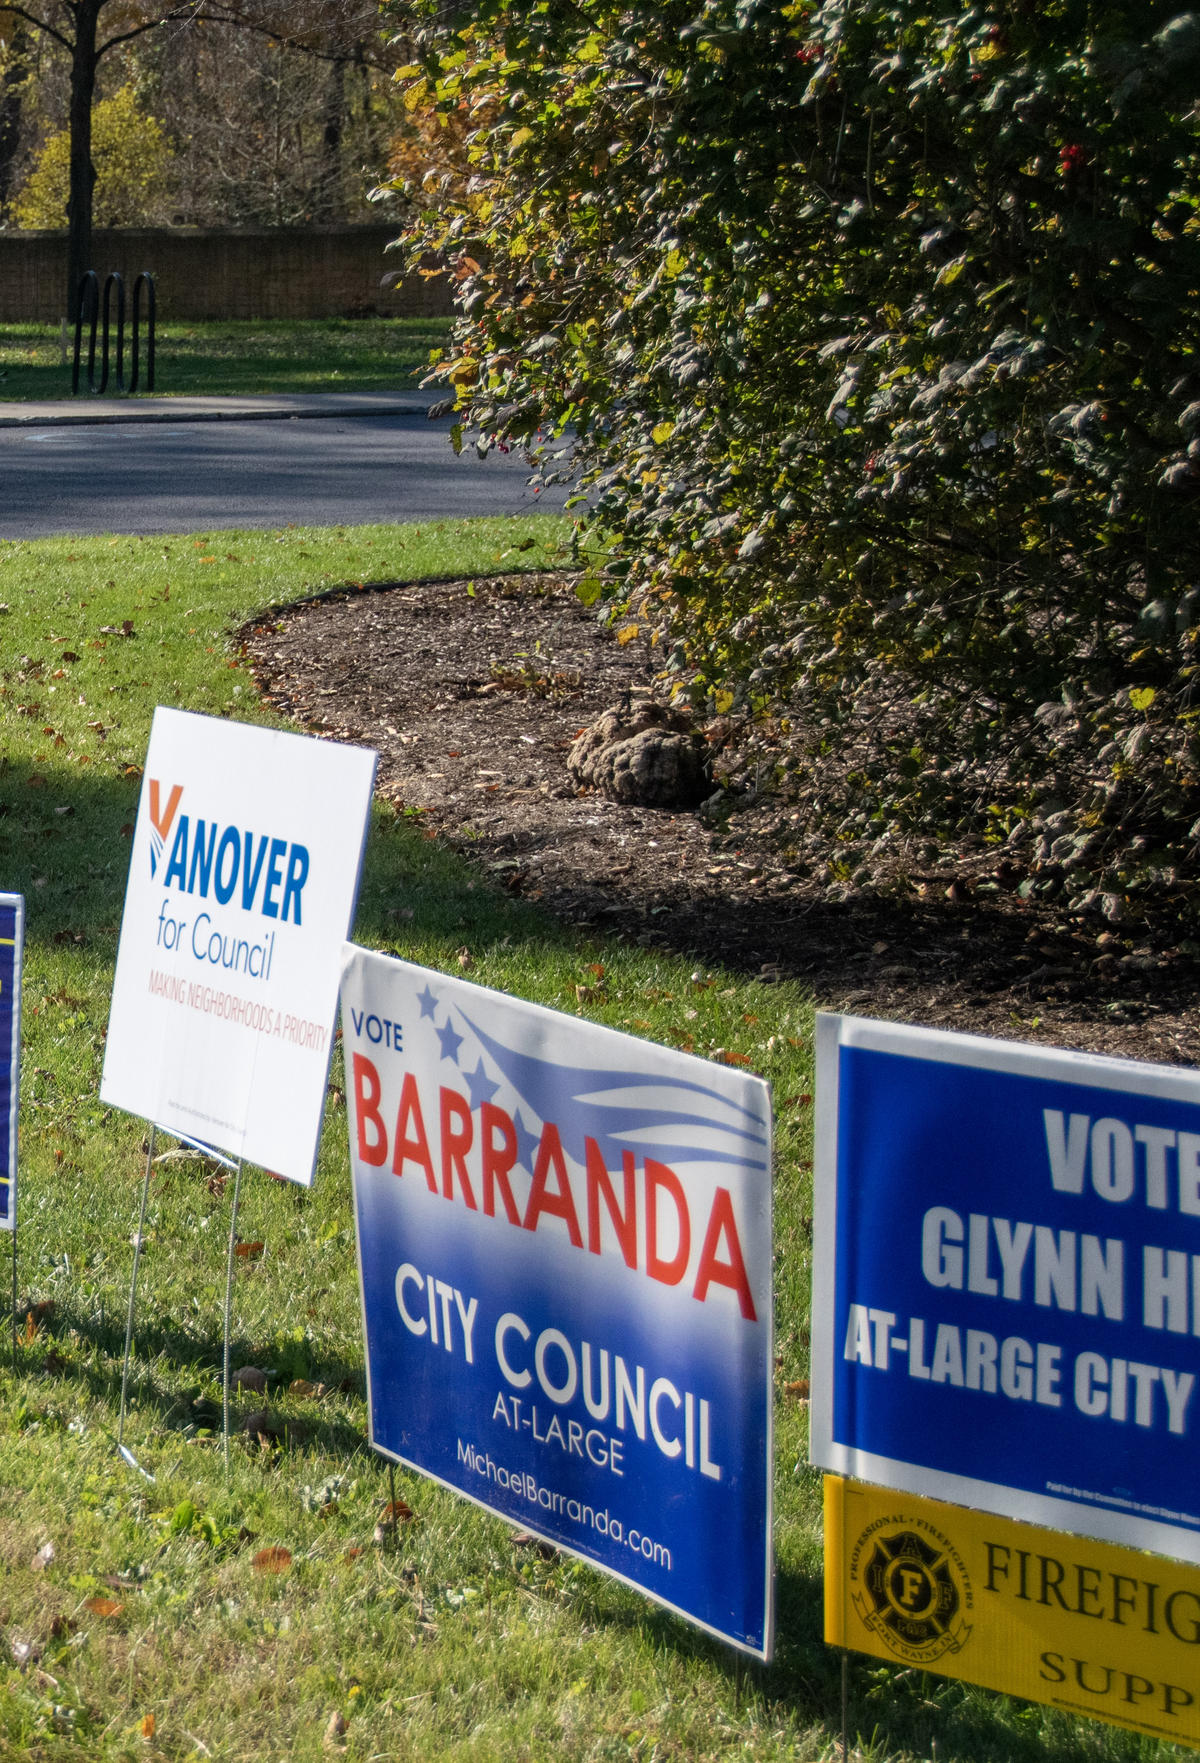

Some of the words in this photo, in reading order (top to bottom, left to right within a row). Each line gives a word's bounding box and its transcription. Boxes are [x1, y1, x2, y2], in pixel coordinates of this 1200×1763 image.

[149, 779, 310, 926] VANOVER
[156, 898, 186, 951] for
[191, 912, 276, 981] Council
[148, 969, 187, 1004] MAKING
[187, 981, 275, 1034] NEIGHBORHOODS
[274, 1011, 282, 1038] A
[283, 1013, 328, 1052] PRIORITY
[350, 1007, 403, 1053] VOTE
[352, 1051, 758, 1323] BARRANDA
[921, 1206, 1124, 1322] GLYNN
[394, 1263, 478, 1364] CITY
[494, 1312, 721, 1481] COUNCIL
[844, 1303, 1062, 1407] AT-LARGE
[1074, 1351, 1195, 1435] CITY
[492, 1391, 625, 1476] AT-LARGE
[456, 1437, 672, 1571] MichaelBarranda.com
[851, 1514, 907, 1581] PROFESSIONAL
[916, 1519, 974, 1609] FIREFIGHTERS
[982, 1541, 1200, 1645] FIREFIG
[872, 1615, 898, 1648] FORT
[1039, 1652, 1195, 1716] SUPP
